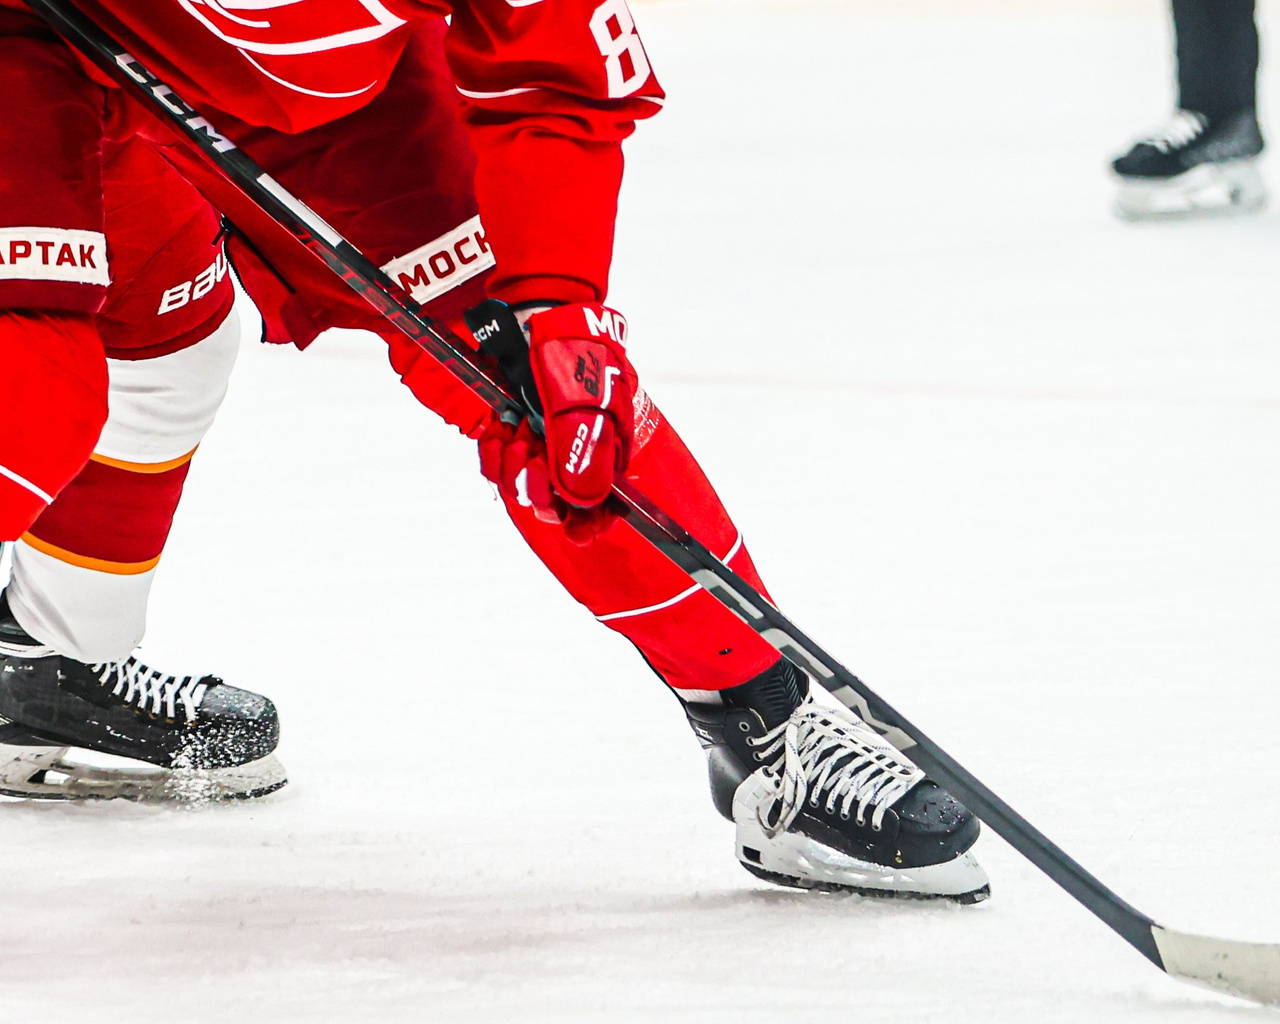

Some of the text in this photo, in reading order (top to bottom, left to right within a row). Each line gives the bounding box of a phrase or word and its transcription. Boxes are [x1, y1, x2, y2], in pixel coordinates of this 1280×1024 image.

[114, 53, 236, 153] CCM
[473, 319, 500, 342] CCM
[566, 423, 588, 474] CCM
[690, 567, 918, 751] CCM
